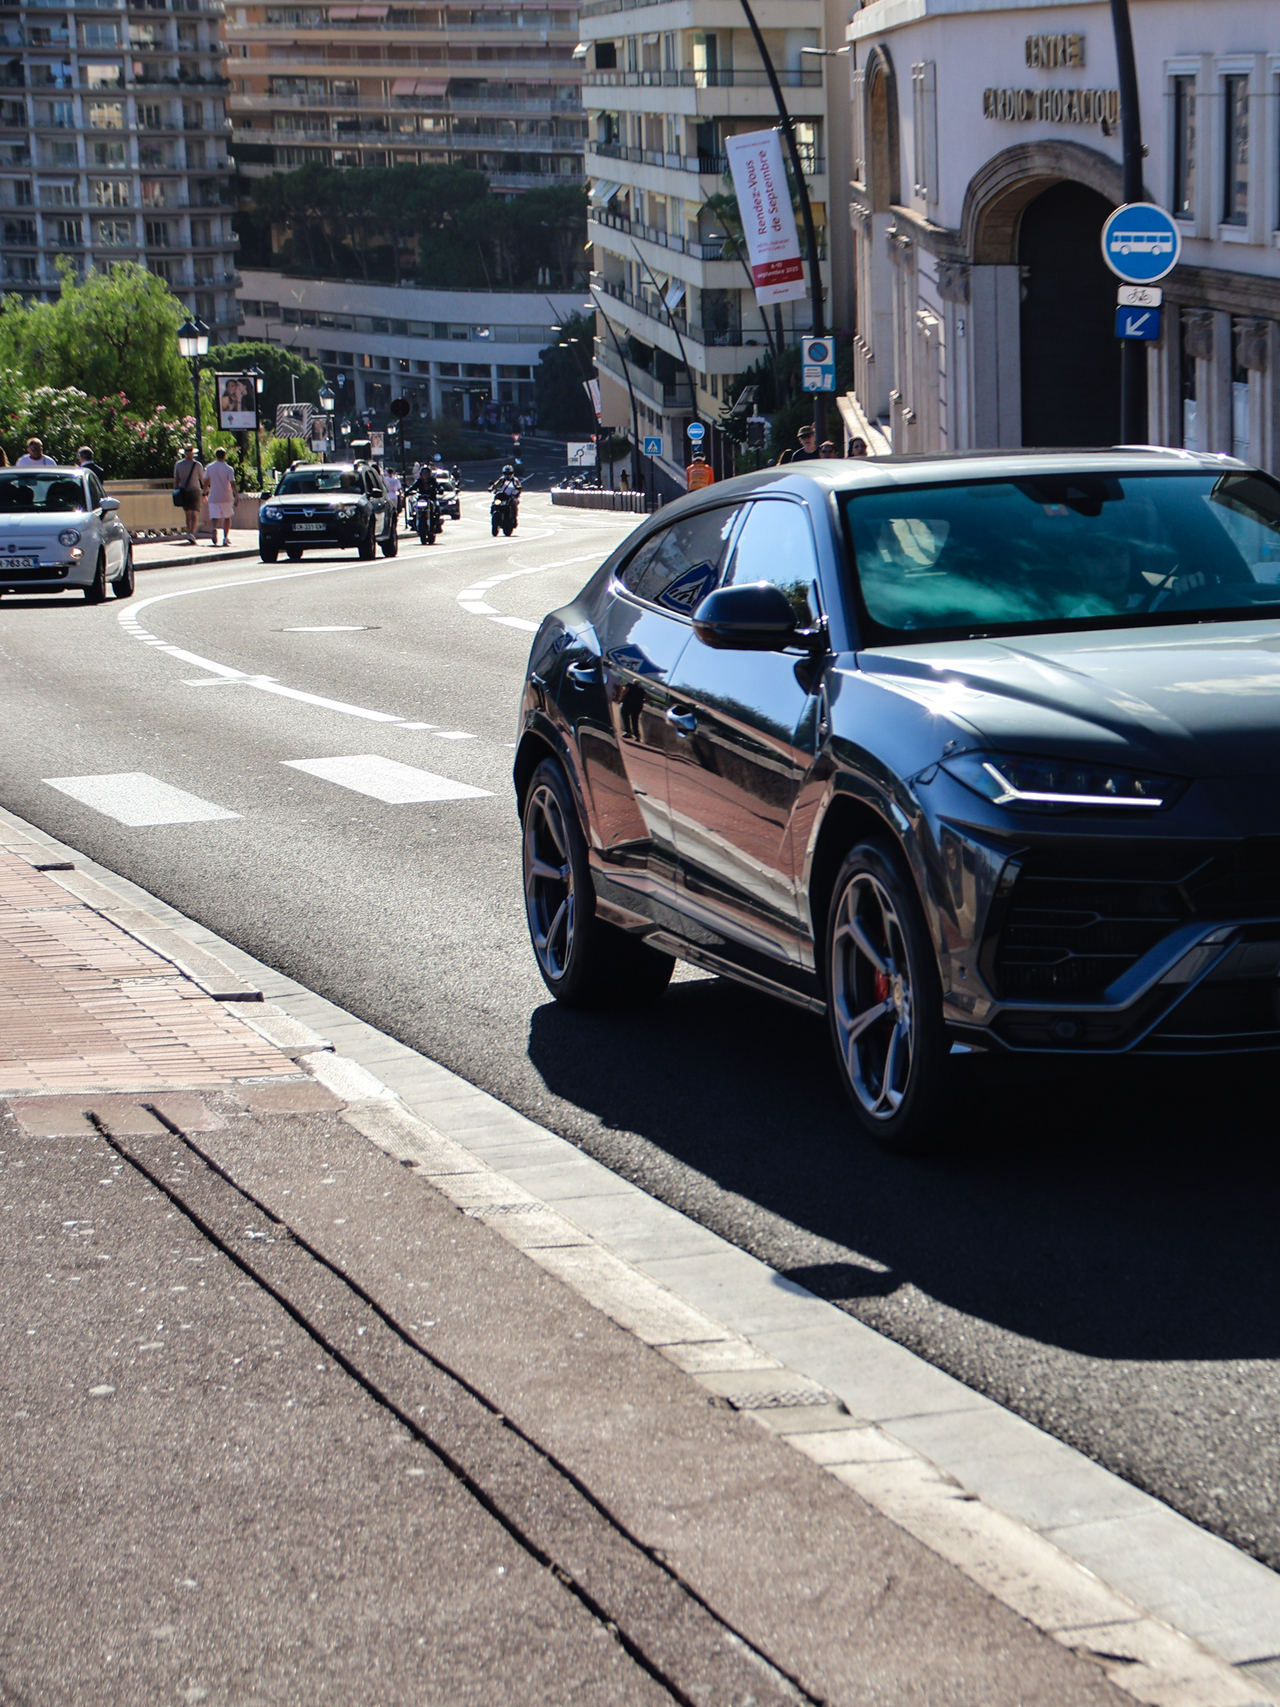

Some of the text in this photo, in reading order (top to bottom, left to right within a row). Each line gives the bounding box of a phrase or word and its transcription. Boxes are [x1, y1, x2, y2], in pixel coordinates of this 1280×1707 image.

[1026, 33, 1086, 68] CENTRE
[983, 88, 1031, 120] CARDIO
[746, 159, 767, 235] Rendez-Vous
[759, 150, 782, 232] de Septembre
